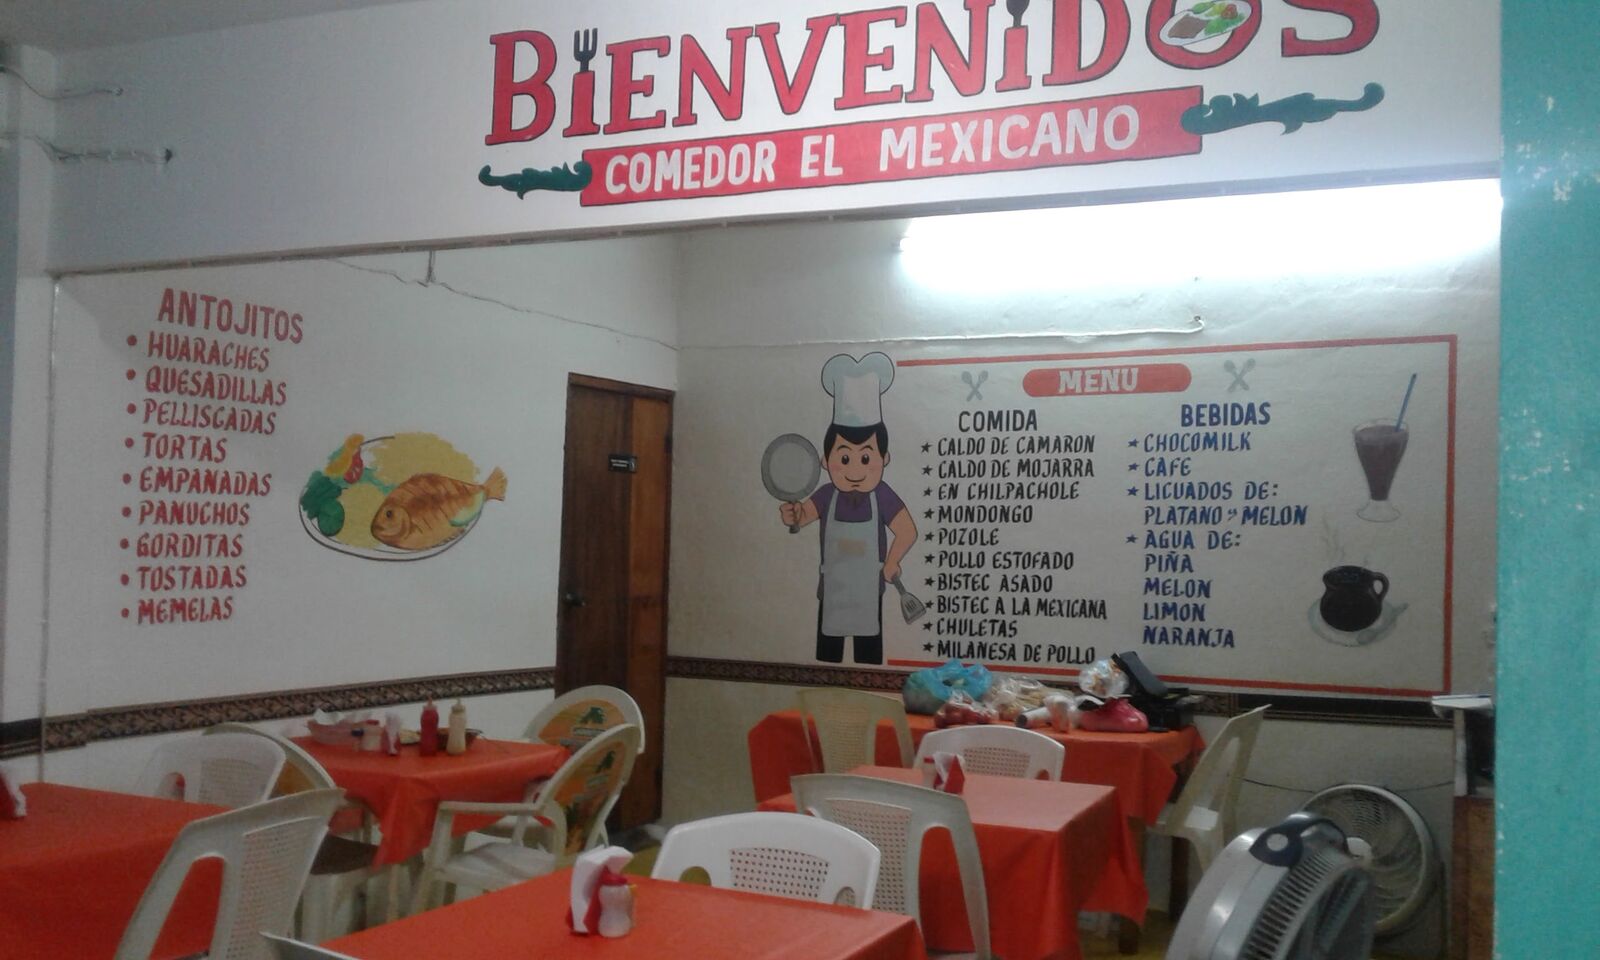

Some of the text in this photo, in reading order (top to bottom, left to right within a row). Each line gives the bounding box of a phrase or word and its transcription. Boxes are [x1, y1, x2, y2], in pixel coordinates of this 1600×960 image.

[605, 105, 1140, 195] COMEDOR EL MEXICANO
[157, 287, 304, 344] ANTOJITOS
[147, 330, 270, 373] HUARACHES
[145, 365, 287, 406] QUESADILLAS
[1058, 367, 1139, 393] MENU
[958, 409, 1038, 432] COMIDA
[1181, 402, 1271, 427] BEBIDAS
[142, 432, 227, 463] TORTAS
[937, 435, 1095, 456] CALDO DE CAMARON
[1144, 432, 1251, 452] CHOCOMILK
[938, 458, 1095, 479] CALDO DE MOJARRA
[1144, 457, 1191, 477] CAFE
[139, 466, 272, 496] EMPANADAS
[938, 481, 1080, 500] EN CHILPACHOLE
[1144, 481, 1278, 500] LICUADOS DE:
[139, 500, 250, 526] PANUCHOS
[938, 505, 1033, 523] MONDONGO
[1144, 506, 1222, 525] PLATANO
[1241, 505, 1309, 526] MELON
[136, 532, 243, 558] GORDITAS
[938, 528, 999, 546] POZOLE
[1144, 530, 1240, 549] AGUA DE:
[938, 550, 1074, 570] POLLO ESTOFADO
[1144, 551, 1194, 573] PIÑA
[137, 565, 247, 591] TOSTADAS
[937, 573, 1053, 592] BISTEC ASADO
[1143, 577, 1213, 598] MELON
[138, 596, 233, 625] MEMELAS
[937, 595, 1107, 620] BISTEC A LA MEXICANA
[1142, 602, 1205, 622] LIMON
[937, 618, 1018, 638] CHULETAS
[1142, 626, 1235, 648] NARANJA
[937, 640, 1096, 664] MILANESA DE POLLO
